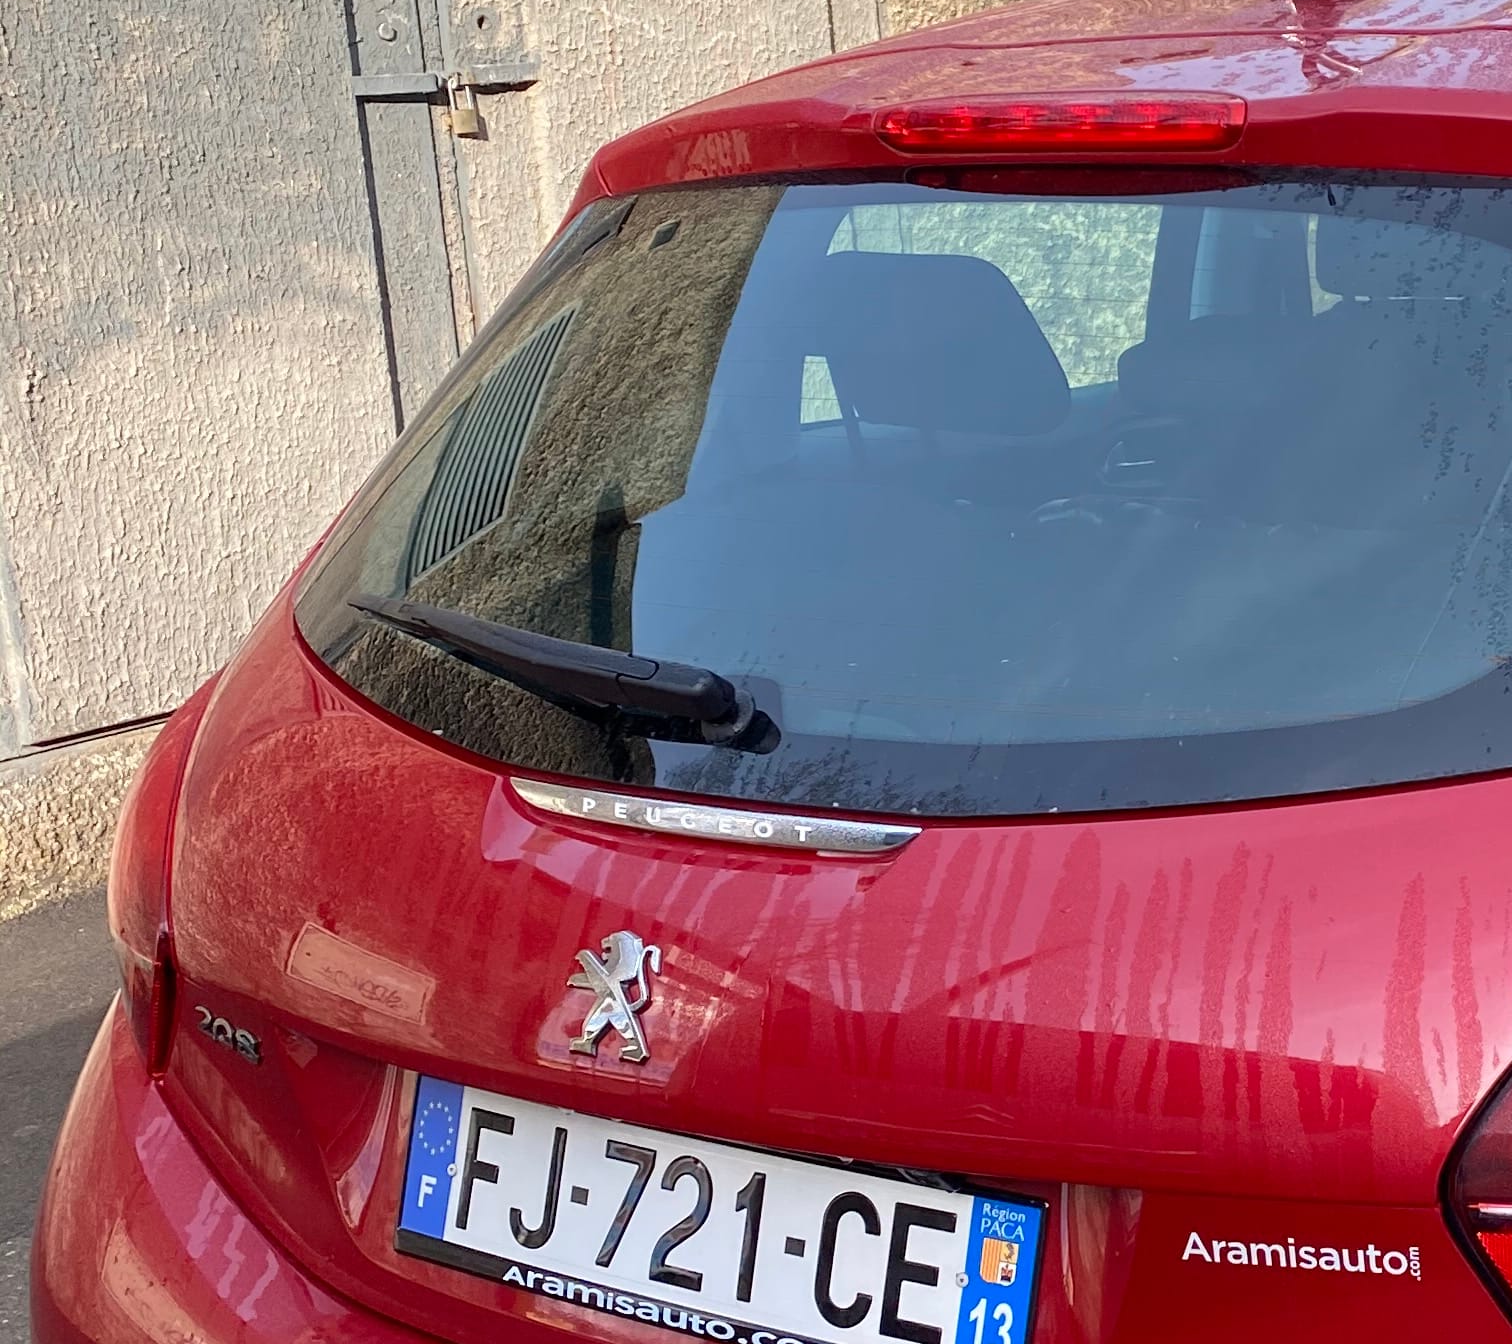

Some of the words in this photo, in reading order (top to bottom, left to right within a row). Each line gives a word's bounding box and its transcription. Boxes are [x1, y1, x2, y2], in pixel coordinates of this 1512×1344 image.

[582, 796, 812, 843] PEUGEOT
[417, 1175, 437, 1209] F
[980, 1217, 1025, 1242] PACA
[982, 1202, 1026, 1223] Région
[1181, 1231, 1409, 1275] Aramisauto
